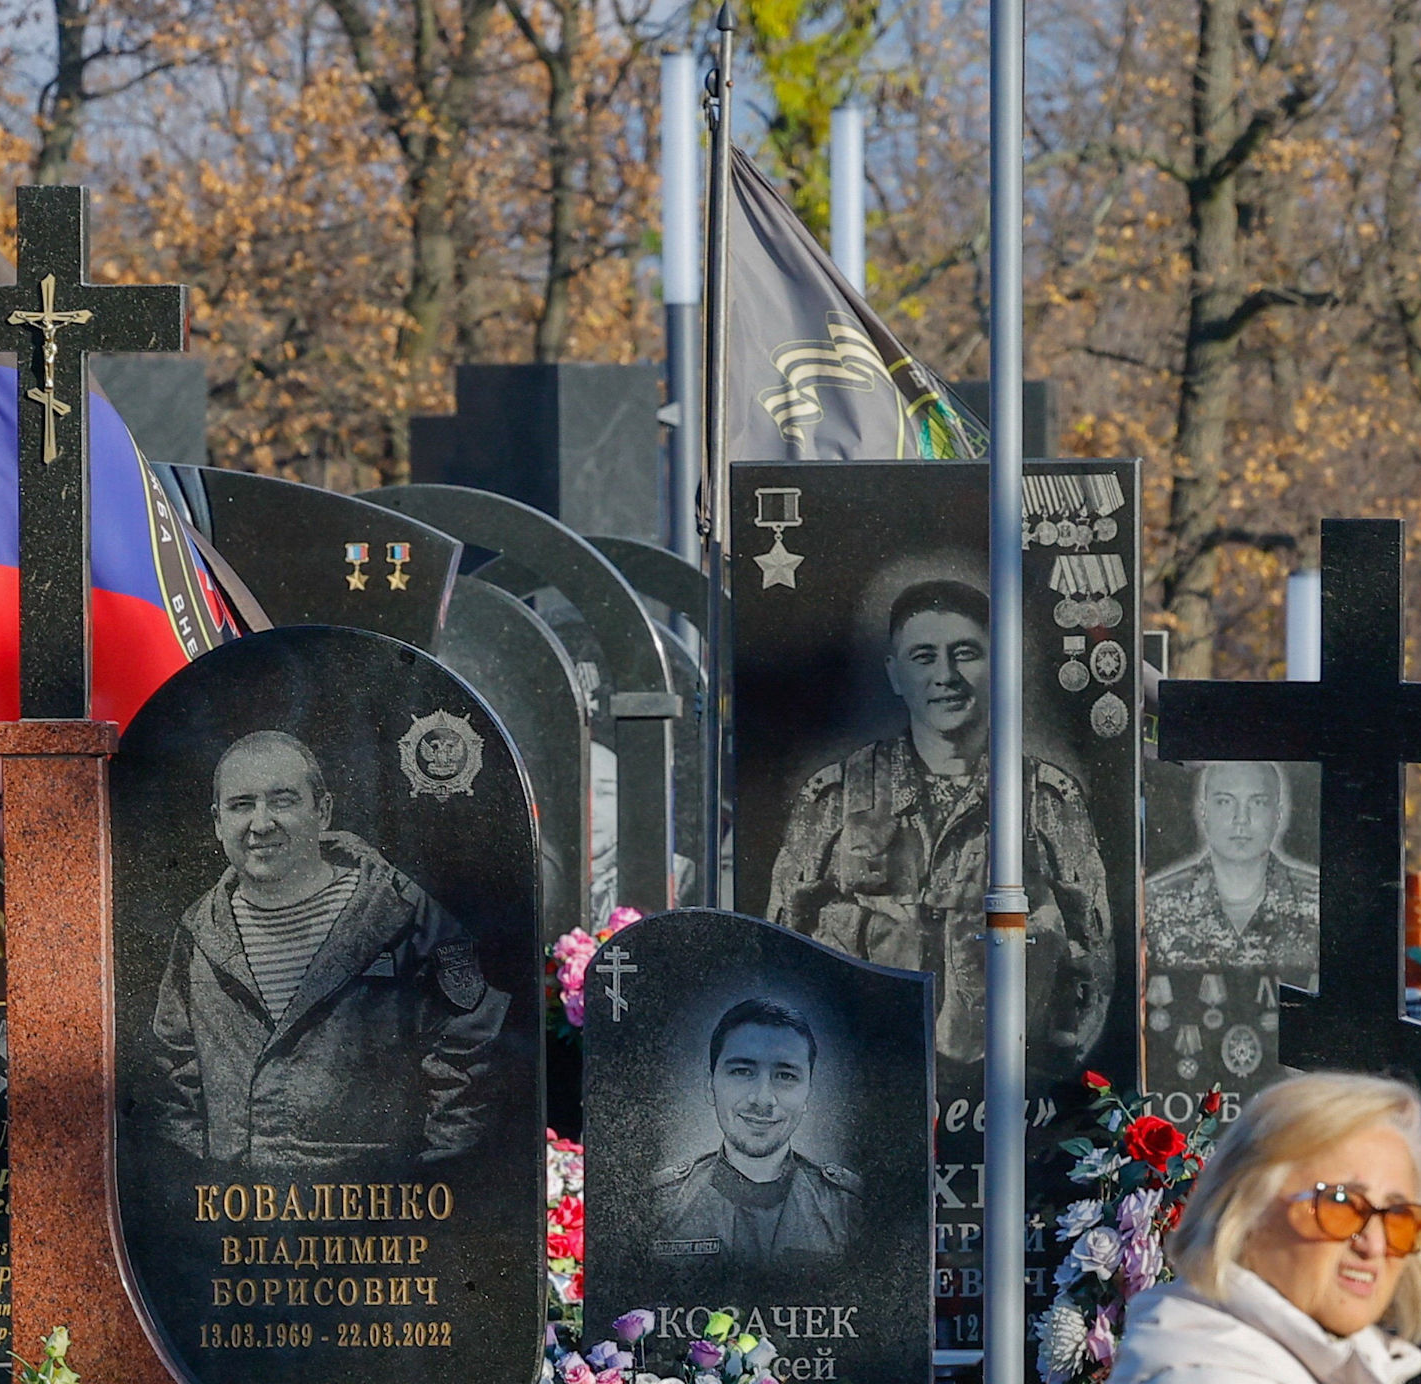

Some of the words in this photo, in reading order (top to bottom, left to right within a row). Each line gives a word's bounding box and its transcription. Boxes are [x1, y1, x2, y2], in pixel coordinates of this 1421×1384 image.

[171, 593, 199, 658] ВНЕ
[194, 1183, 454, 1221] КОВАЛЕНКО
[221, 1236, 429, 1270] ВЛАДИМИР
[211, 1277, 438, 1306] БОРИСОВИЧ
[199, 1324, 313, 1348] 13.03.1969
[337, 1322, 452, 1348] 22.03.2022
